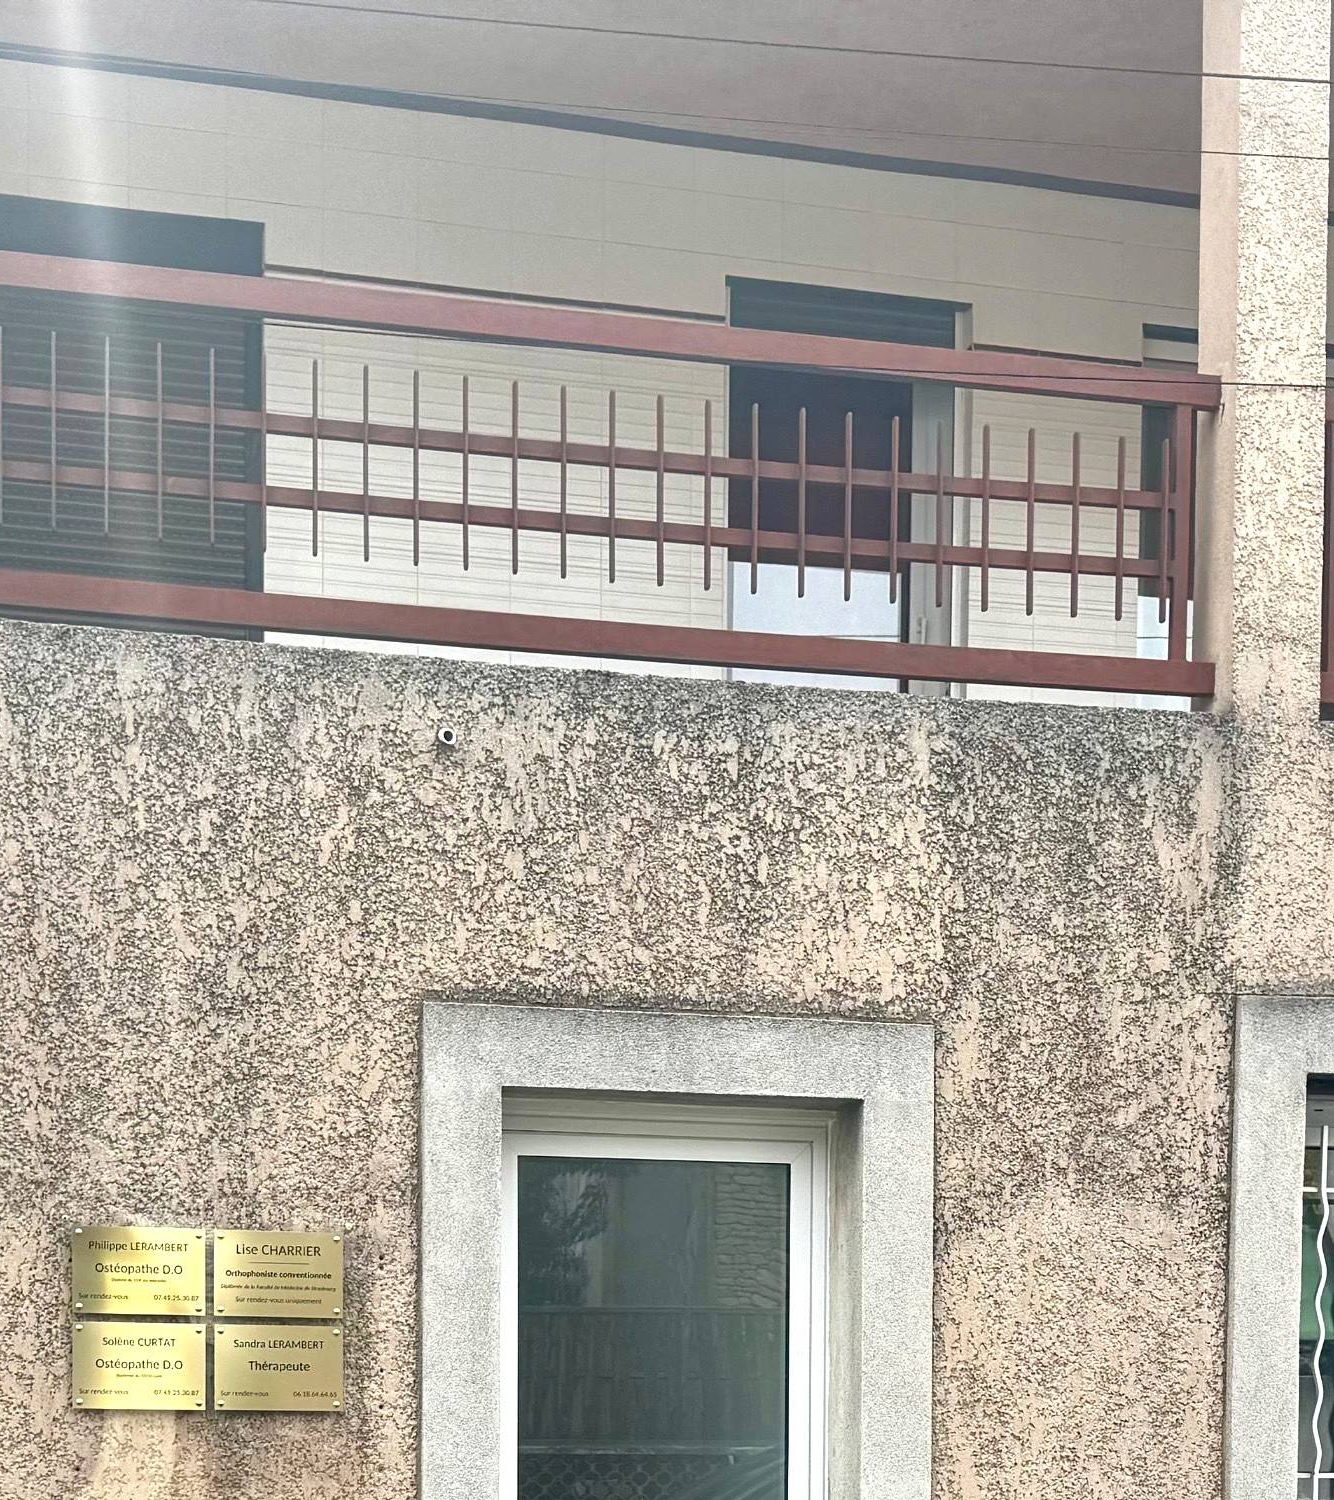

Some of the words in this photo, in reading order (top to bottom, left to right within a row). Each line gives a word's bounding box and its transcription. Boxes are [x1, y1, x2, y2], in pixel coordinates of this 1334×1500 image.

[88, 1240, 128, 1252] Philippe
[130, 1242, 188, 1252] LERAMBERT
[236, 1244, 258, 1255] Lise
[262, 1244, 321, 1256] CHARRIER
[95, 1262, 160, 1275] Ostéopathe
[162, 1264, 183, 1274] D.O
[226, 1270, 278, 1279] Orthophoniste
[279, 1271, 332, 1280] conventionnée
[102, 1336, 134, 1346] Solène
[138, 1338, 176, 1347] CURTAT
[234, 1339, 266, 1348] Sandra
[268, 1340, 324, 1350] LERAMBERT
[95, 1358, 160, 1370] Ostéopathe
[163, 1360, 184, 1370] D.O
[248, 1360, 310, 1372] Thérapeute
